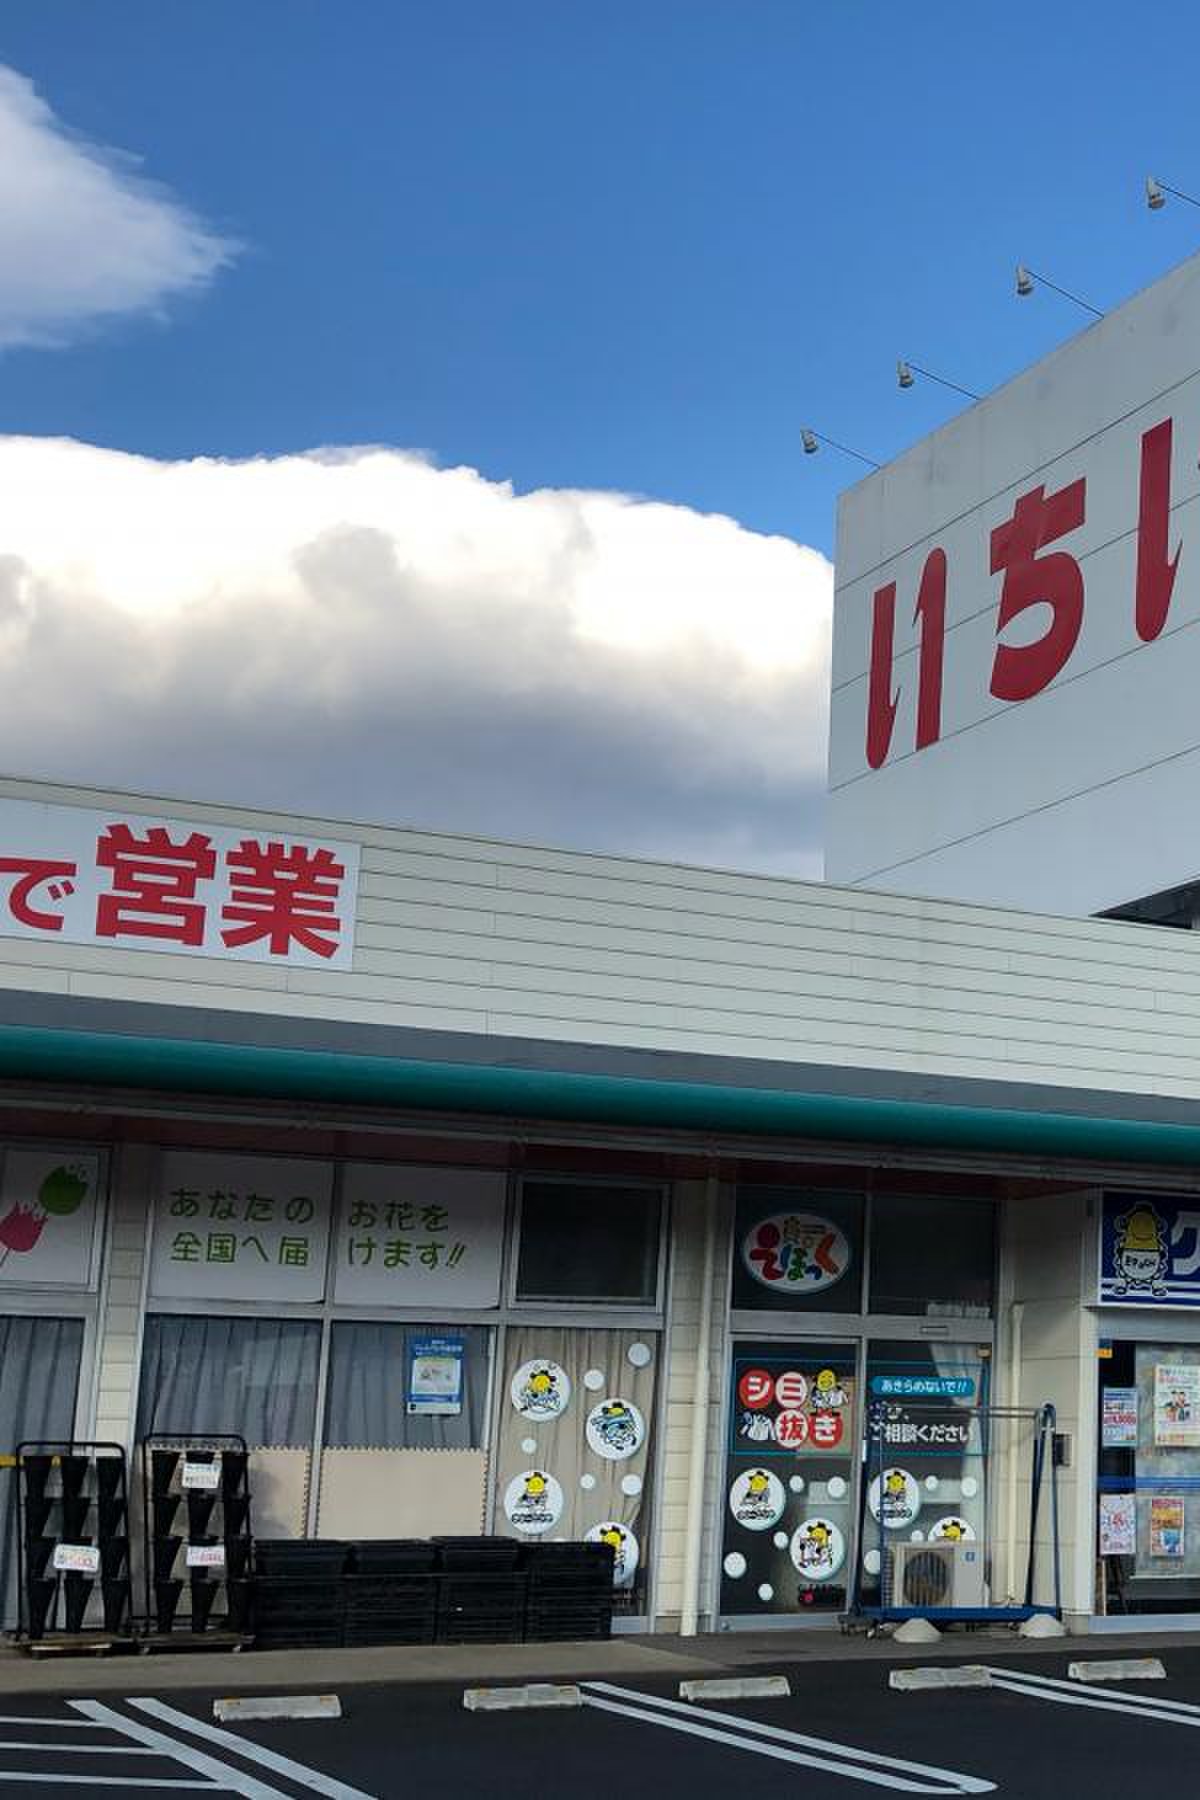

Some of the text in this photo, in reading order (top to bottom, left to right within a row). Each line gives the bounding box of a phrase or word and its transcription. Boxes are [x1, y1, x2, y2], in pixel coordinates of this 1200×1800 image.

[0, 824, 345, 959] で営業
[169, 1188, 449, 1232] あなたの お花を
[169, 1231, 310, 1267] 全国へ届
